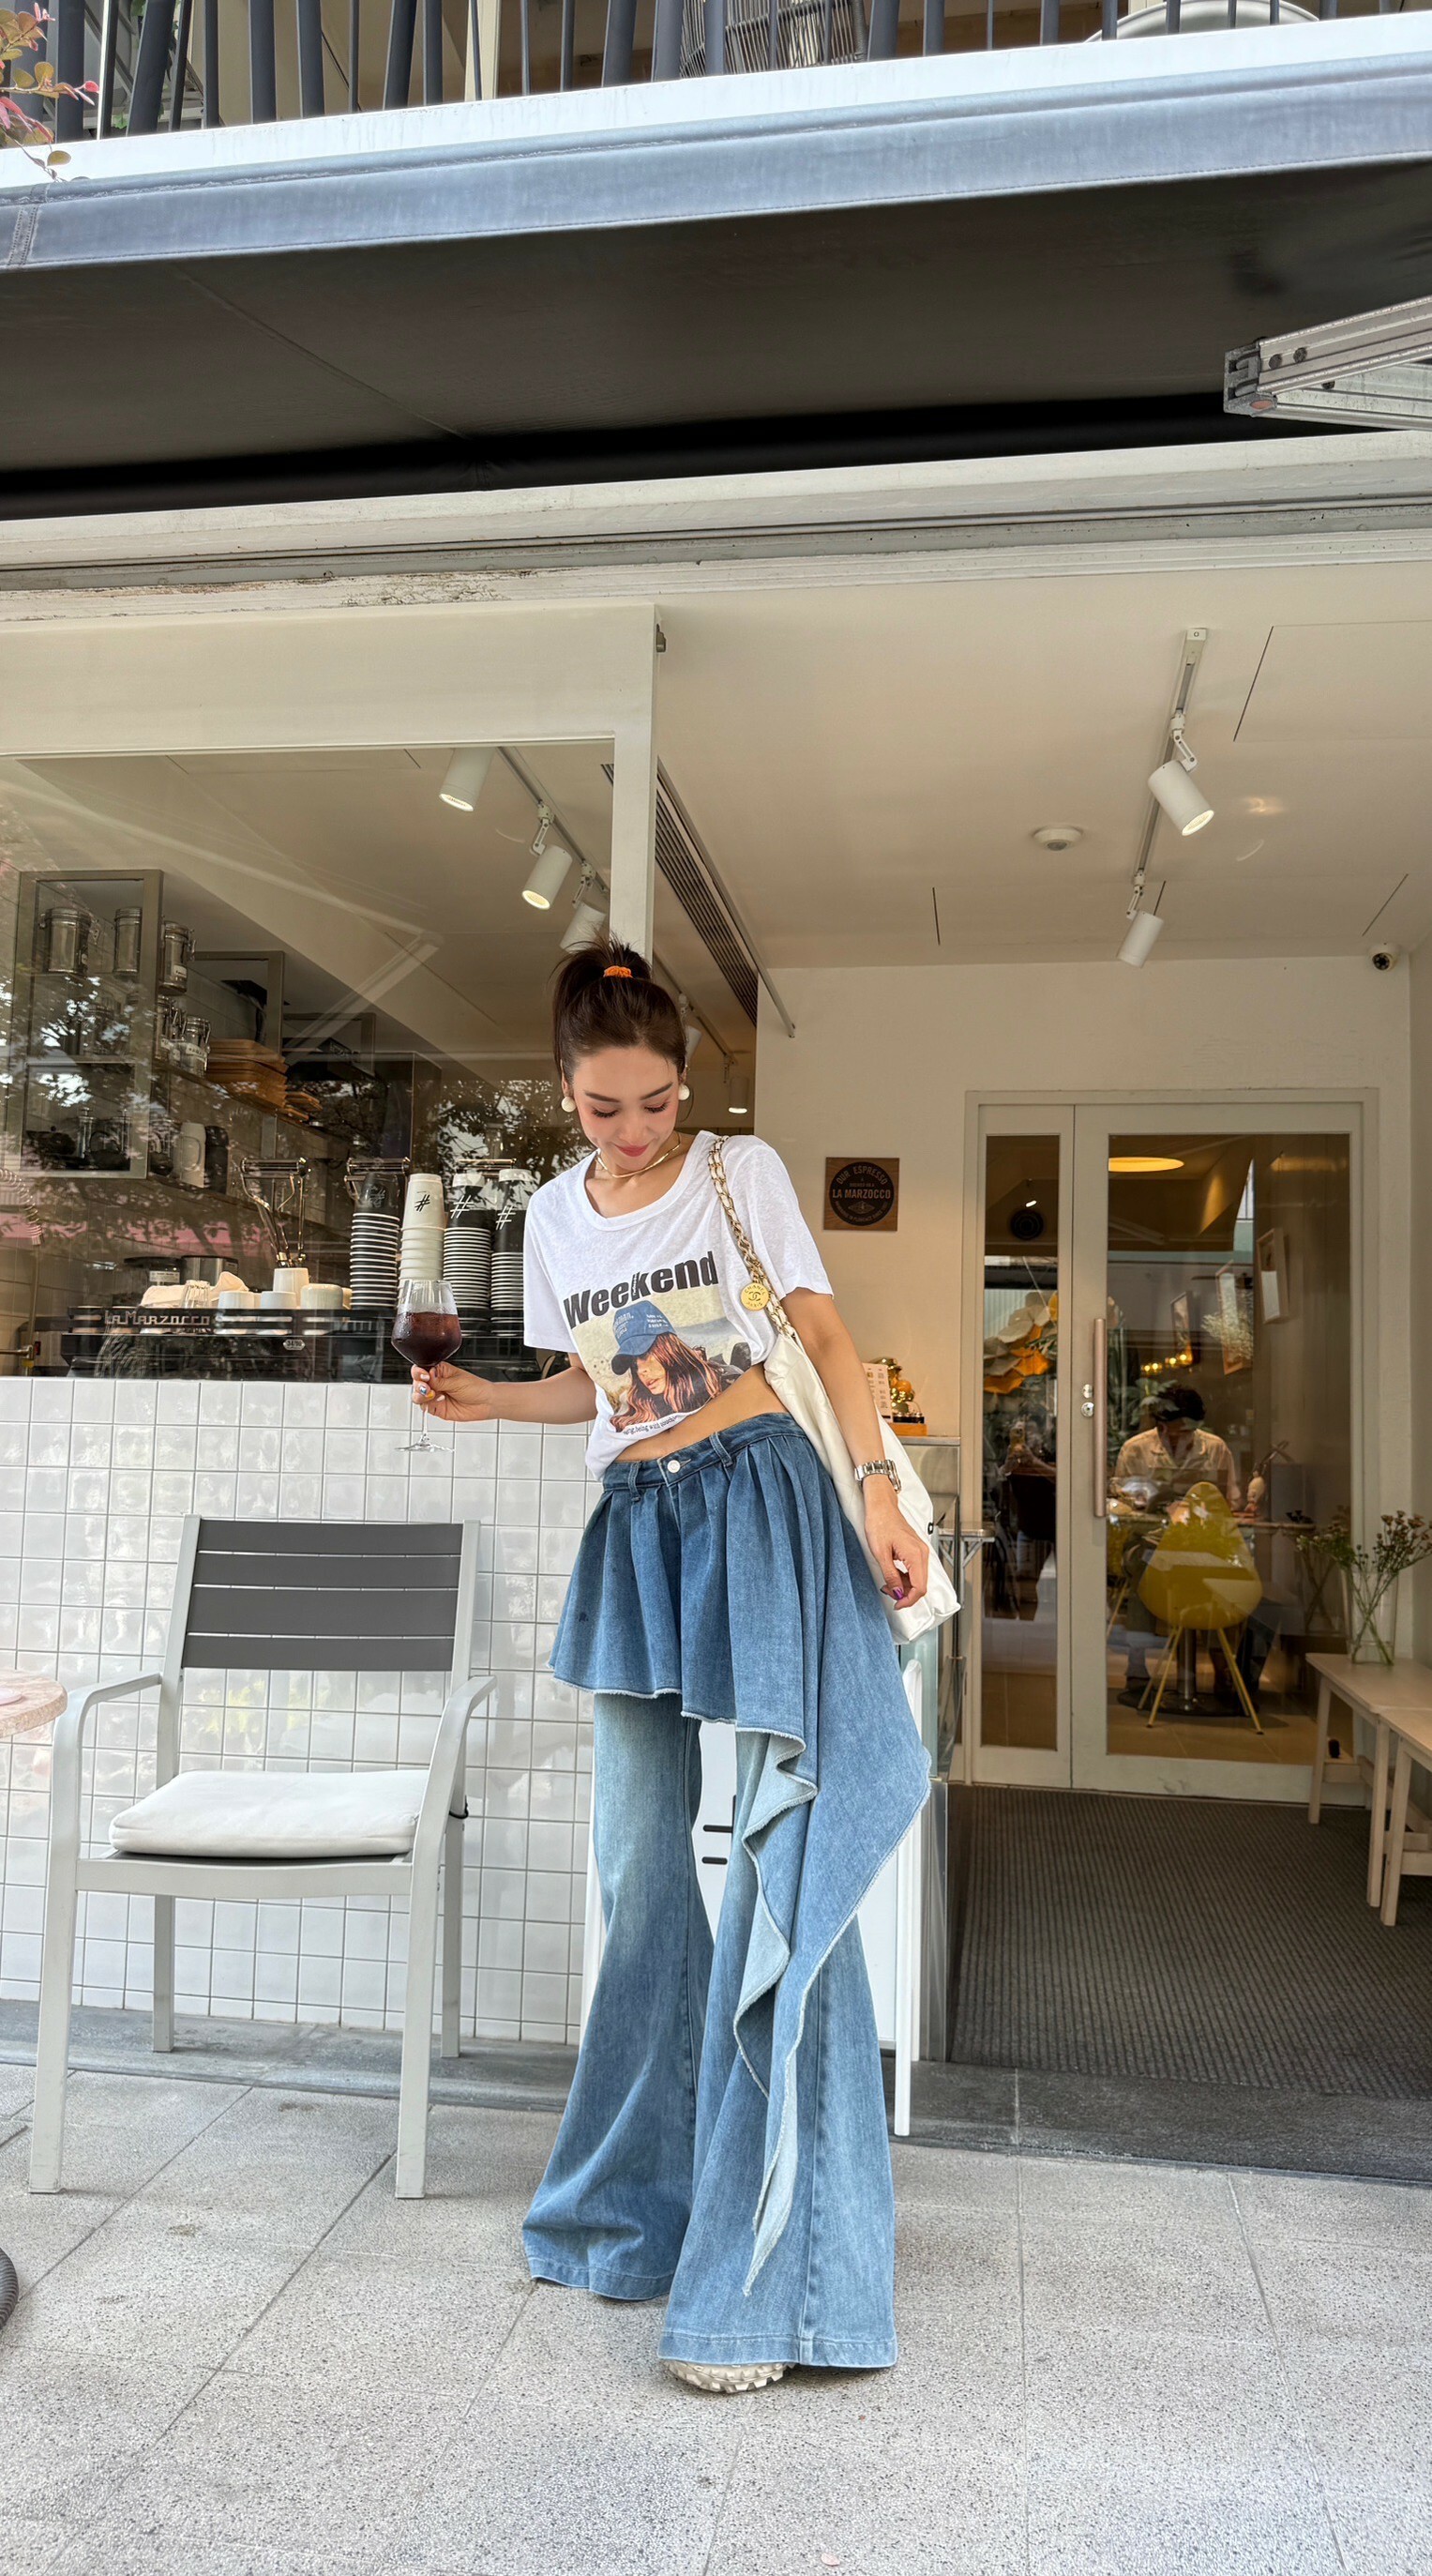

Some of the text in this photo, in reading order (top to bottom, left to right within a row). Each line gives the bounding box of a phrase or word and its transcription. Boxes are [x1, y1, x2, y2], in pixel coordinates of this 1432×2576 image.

[837, 1165, 887, 1185] OUR ESPRESSO
[833, 1189, 891, 1199] LA MARZOCCO
[563, 1250, 719, 1330] Weekend
[745, 1284, 765, 1296] CHANEL
